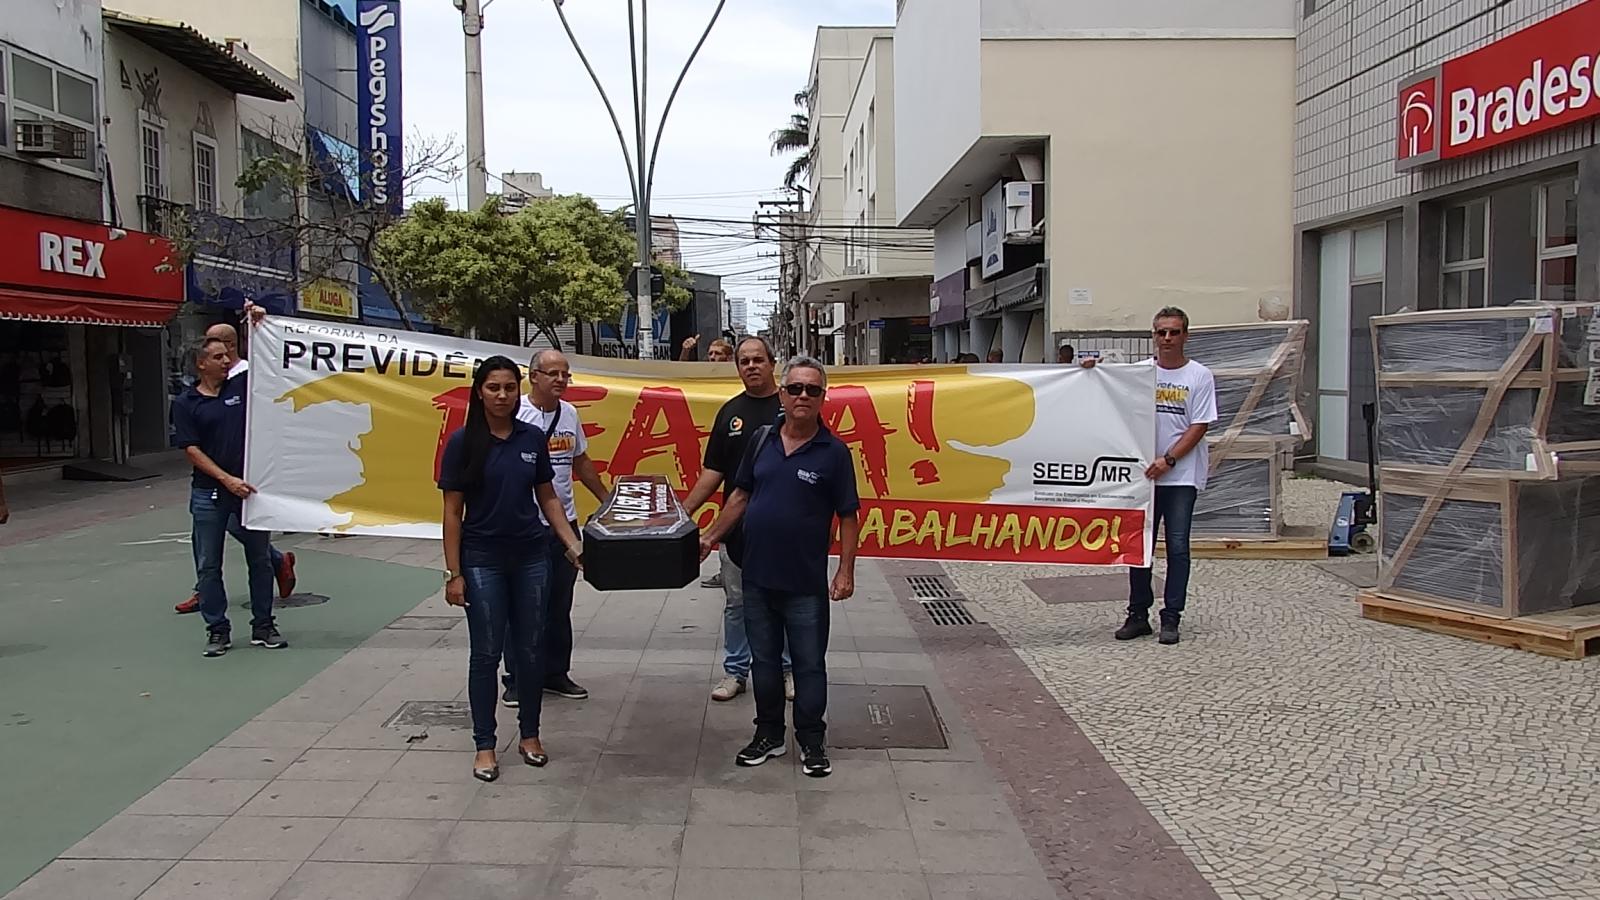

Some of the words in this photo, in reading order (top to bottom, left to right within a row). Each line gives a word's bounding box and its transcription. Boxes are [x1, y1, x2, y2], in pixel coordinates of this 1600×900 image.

[369, 36, 389, 205] Pegshoes
[39, 231, 106, 279] REX
[377, 333, 399, 345] DA
[1032, 462, 1088, 481] SEEB
[1101, 465, 1132, 483] MR
[834, 507, 1122, 554] ABALHANDO!
